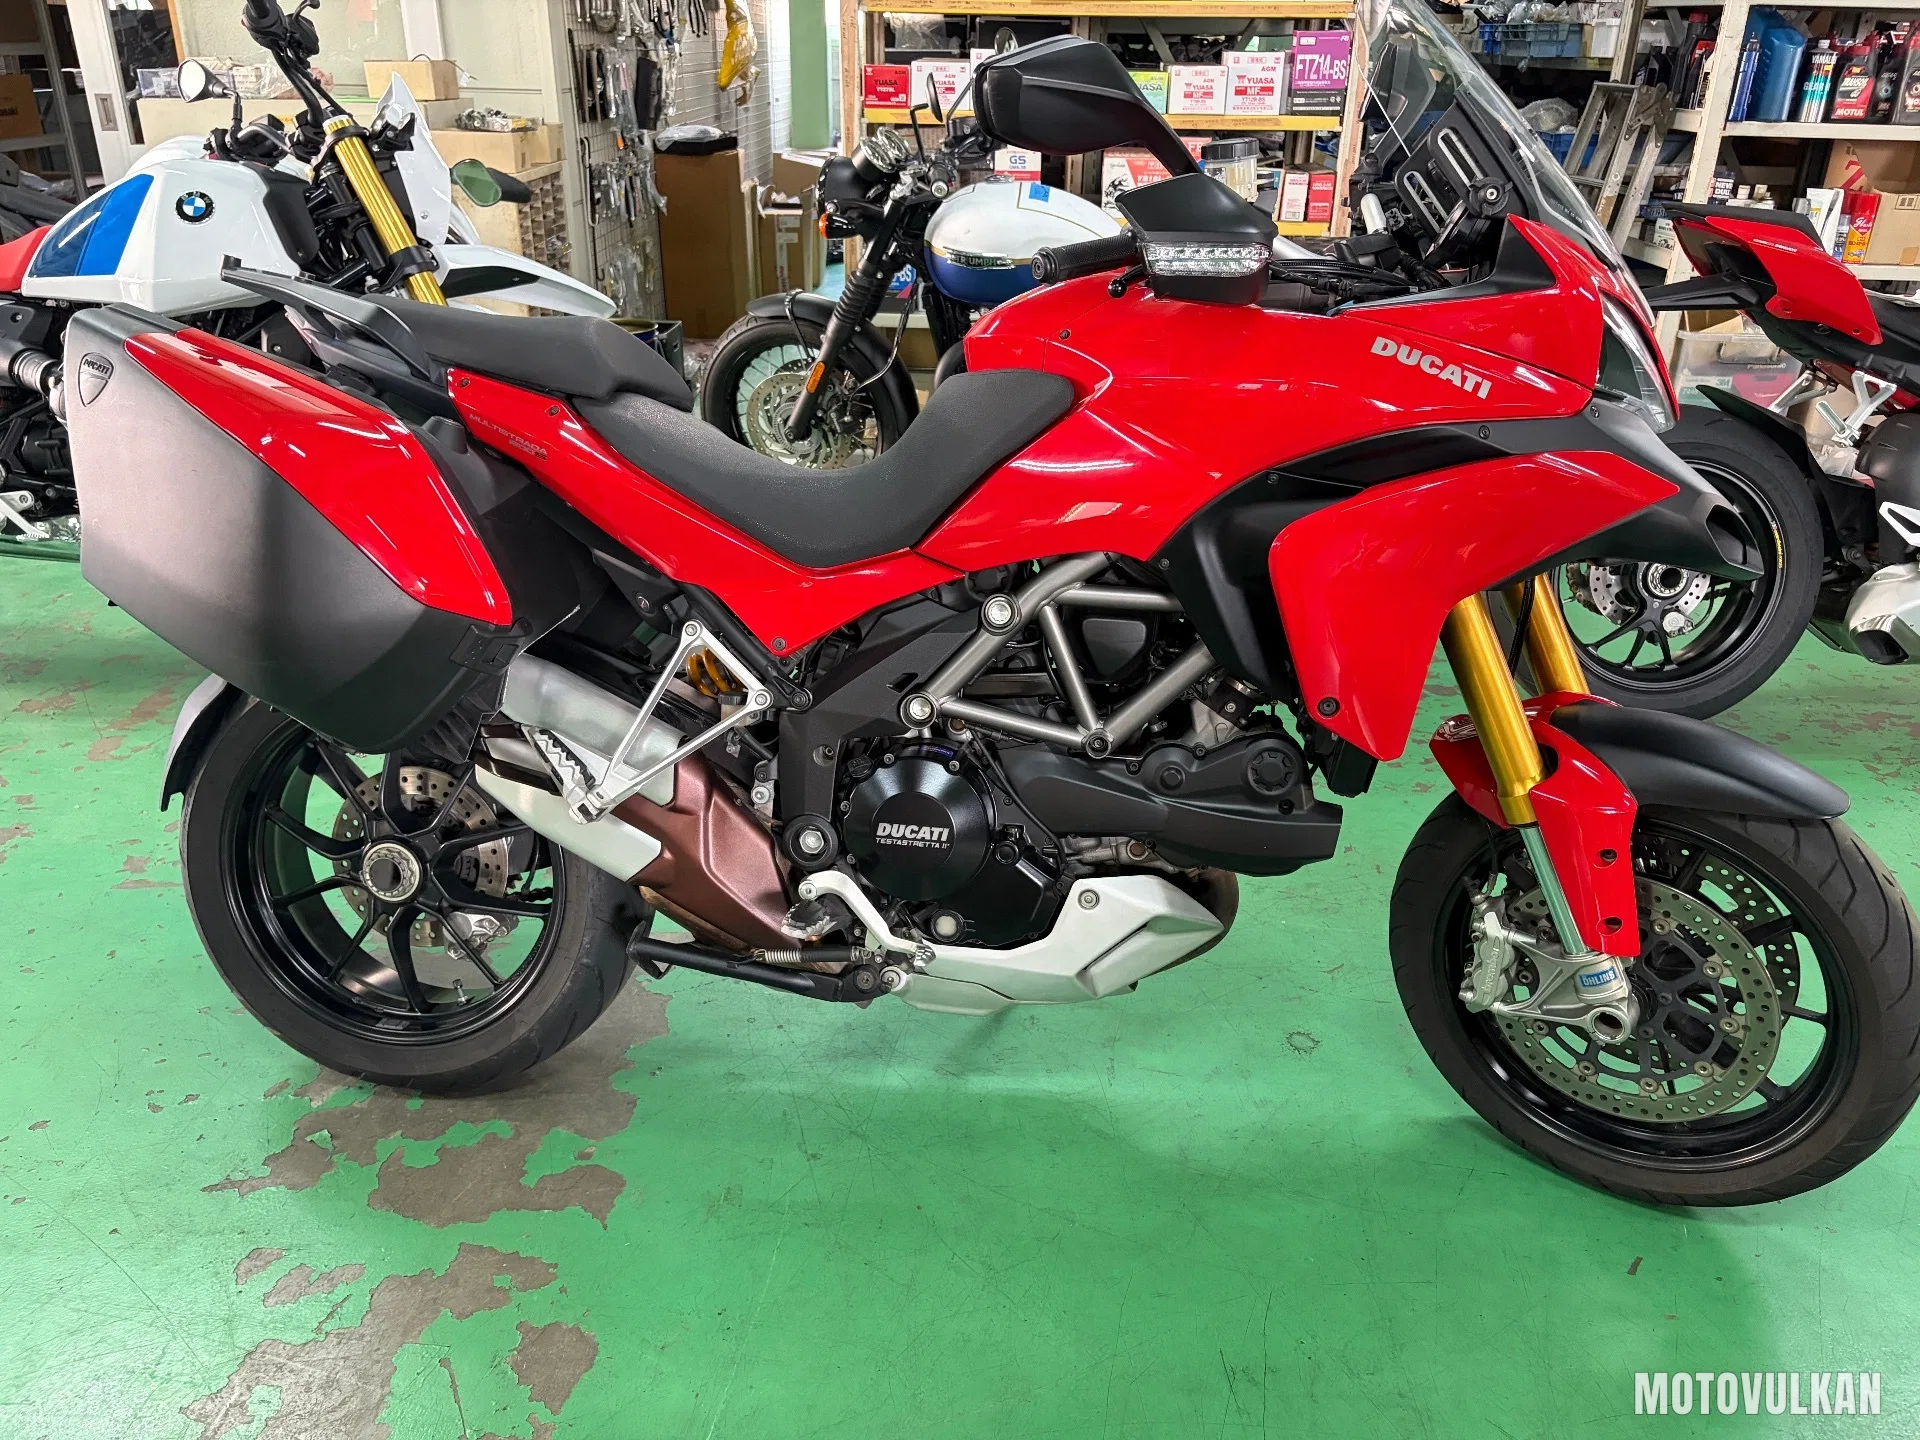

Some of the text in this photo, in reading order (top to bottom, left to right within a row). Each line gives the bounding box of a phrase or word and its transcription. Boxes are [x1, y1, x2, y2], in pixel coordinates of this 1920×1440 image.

[1295, 54, 1347, 80] FTZ14-BS
[1247, 77, 1275, 85] YUASA
[1835, 108, 1865, 117] MOTUL
[1009, 155, 1027, 165] GS
[955, 256, 998, 266] TRUMPH
[83, 358, 111, 374] DUCATI
[1370, 336, 1493, 400] DUCATI
[876, 822, 950, 842] DUCATI
[876, 837, 940, 849] TESTASTRETTA
[1582, 969, 1616, 986] ÖHLINS
